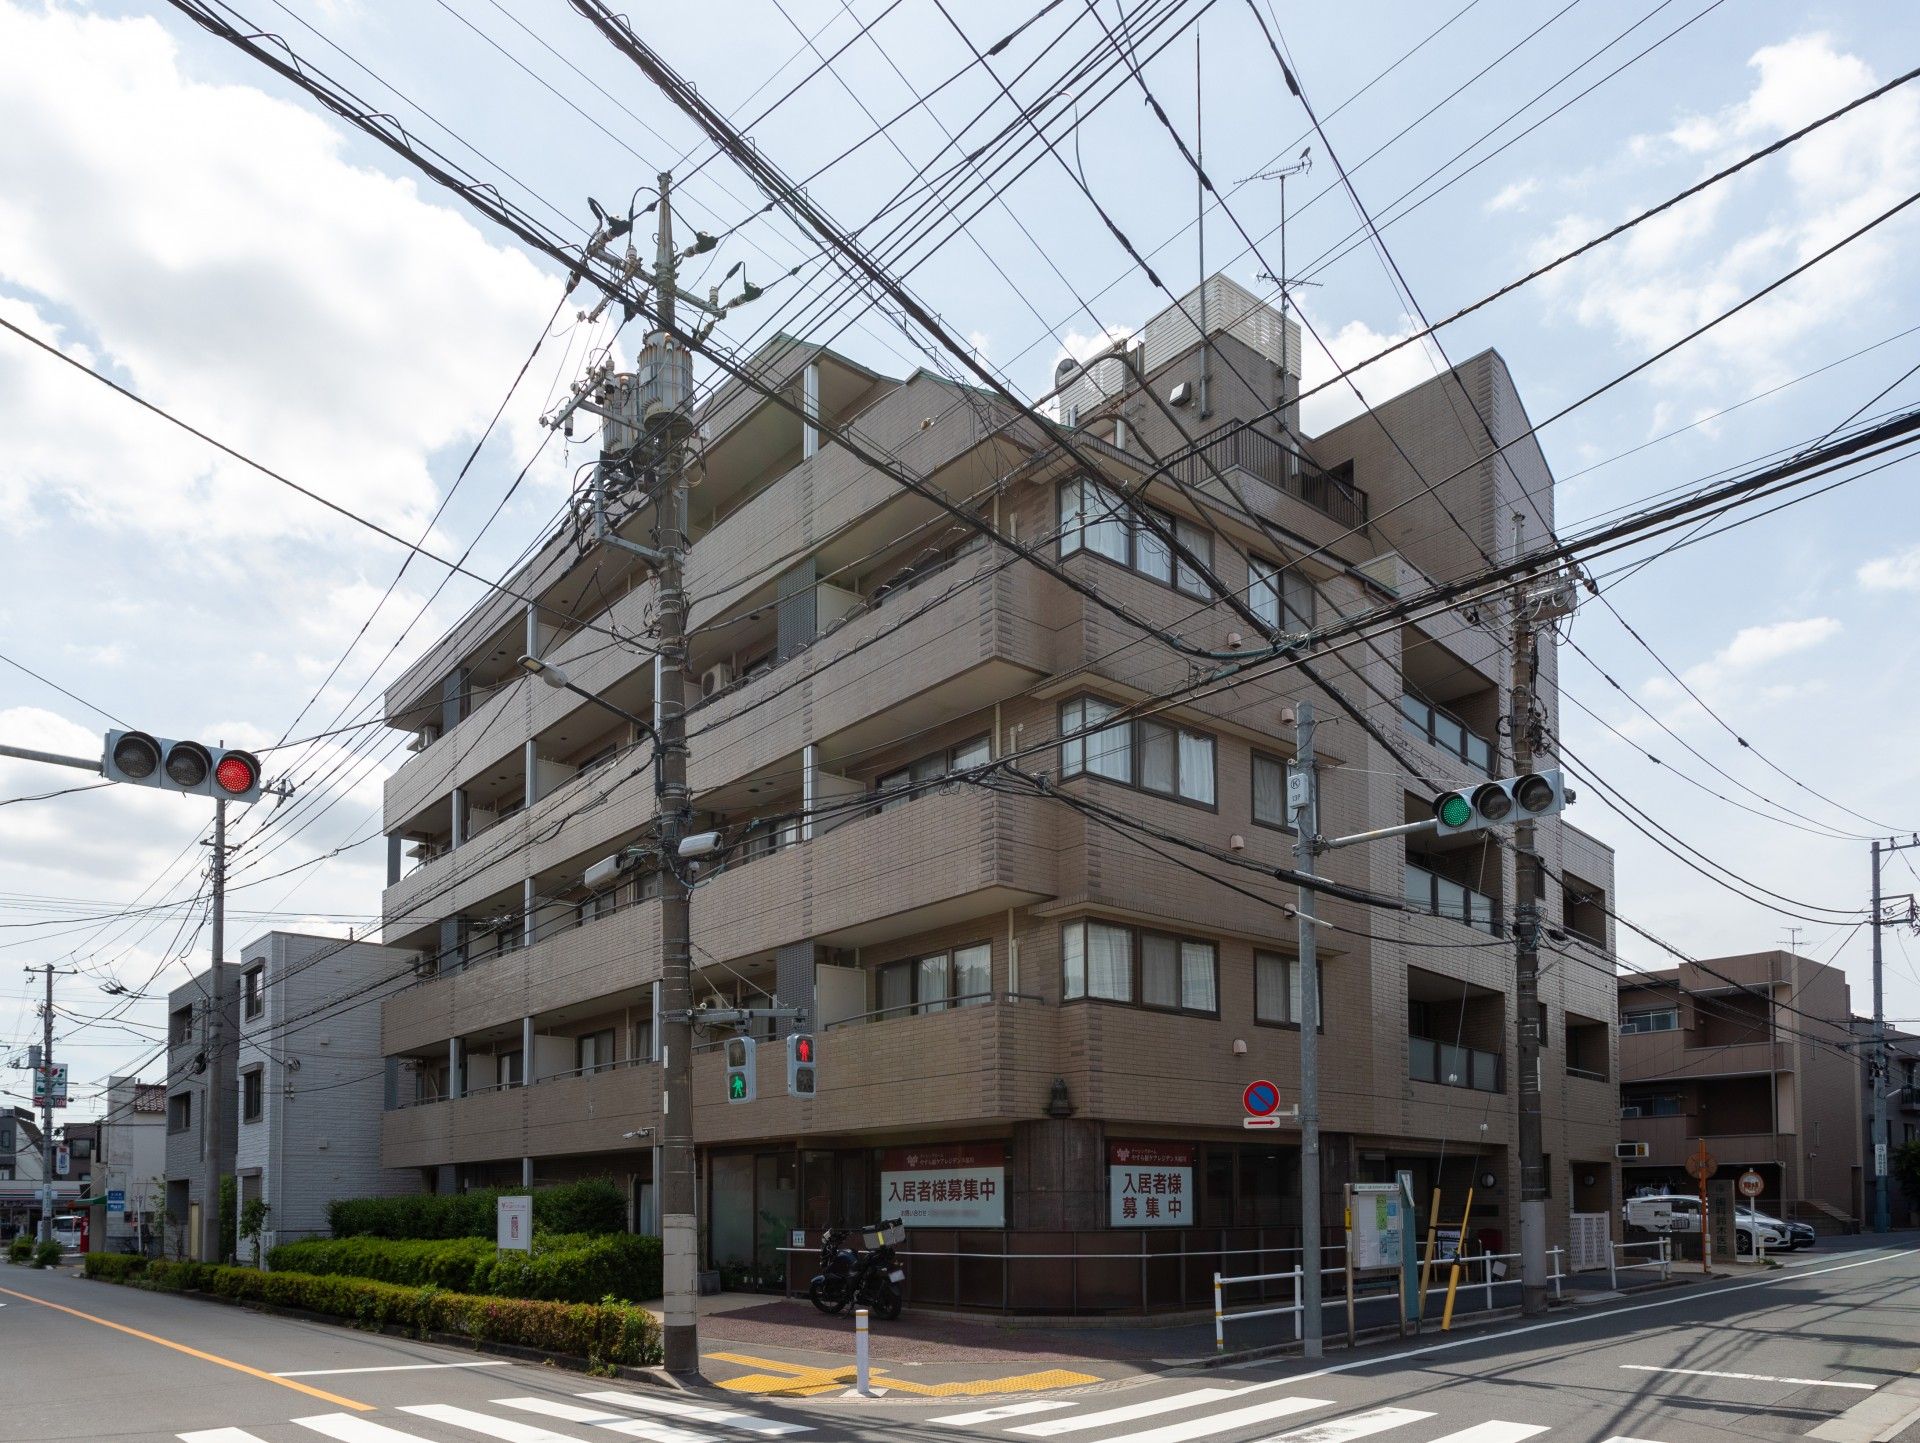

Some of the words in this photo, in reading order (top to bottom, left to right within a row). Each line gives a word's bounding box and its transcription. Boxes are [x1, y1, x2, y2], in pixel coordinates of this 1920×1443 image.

[889, 1178, 996, 1202] 入居者様募集中
[1122, 1173, 1183, 1195] 入居者様
[1122, 1197, 1183, 1219] 募集中
